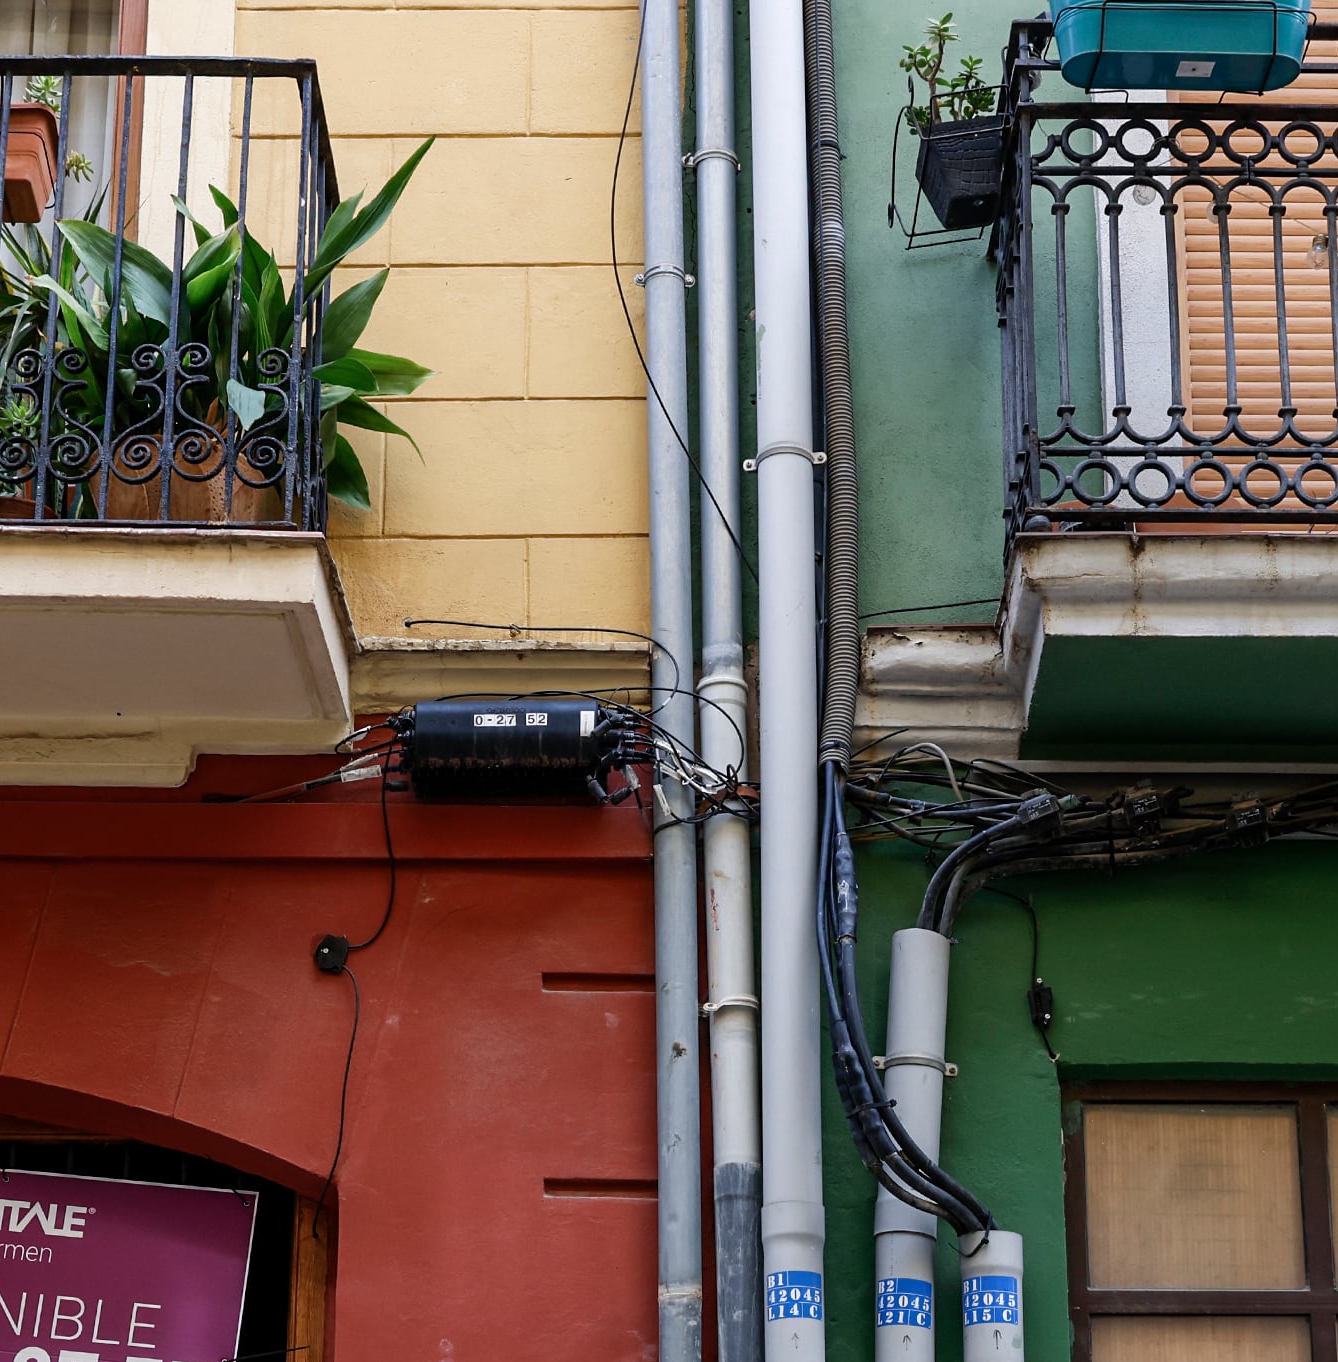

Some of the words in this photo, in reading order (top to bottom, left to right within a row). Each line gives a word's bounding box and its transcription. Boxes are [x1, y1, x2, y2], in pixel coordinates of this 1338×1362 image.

[526, 713, 547, 725] 52
[767, 1273, 784, 1289] B1
[878, 1280, 895, 1295] B2
